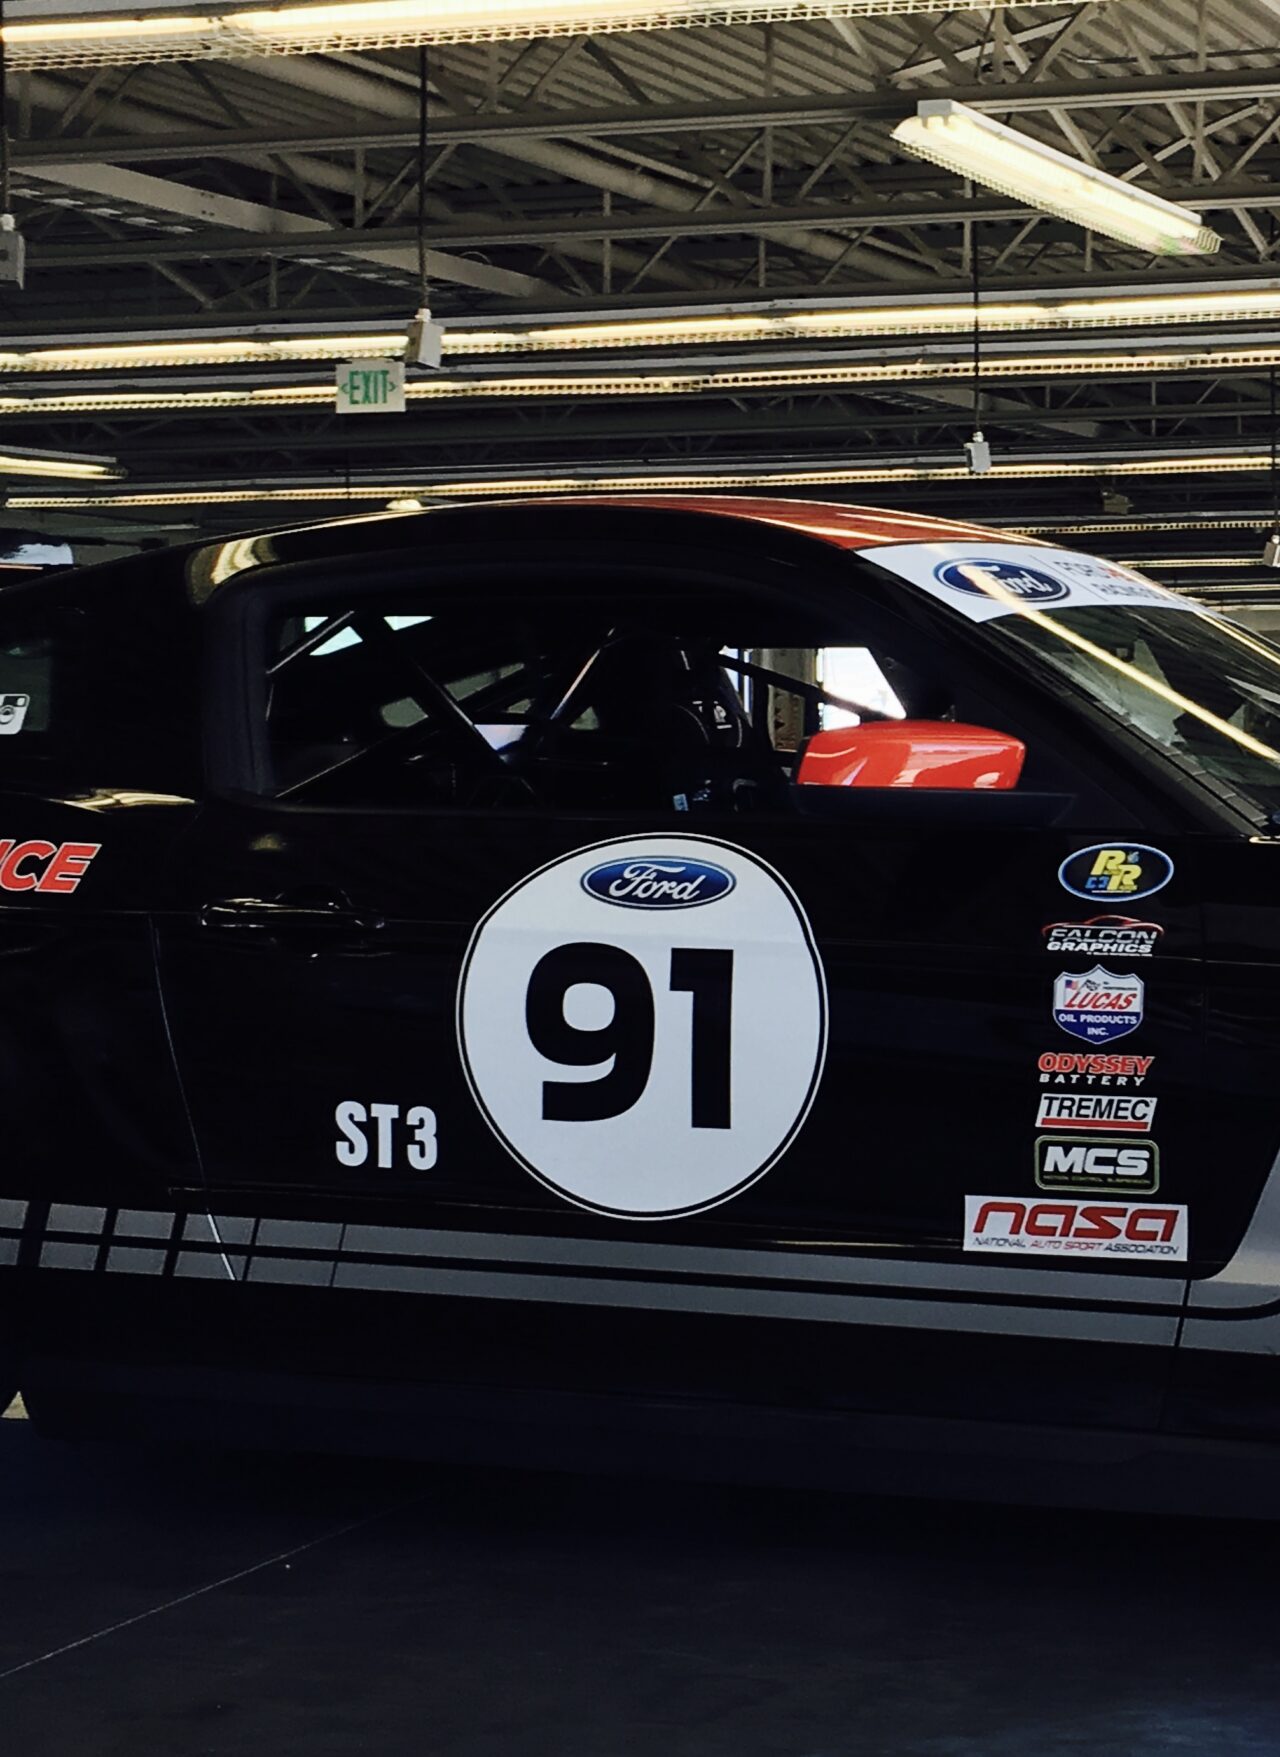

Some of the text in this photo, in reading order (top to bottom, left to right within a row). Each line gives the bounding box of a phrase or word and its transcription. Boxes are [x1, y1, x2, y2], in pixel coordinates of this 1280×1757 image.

[349, 370, 389, 404] EXIT
[0, 839, 102, 893] CE
[609, 863, 706, 900] Ford
[1049, 928, 1158, 945] FALCON
[1046, 941, 1153, 954] GRAPHICS
[1064, 992, 1138, 1010] LUCAS
[1058, 1013, 1138, 1025] OIL PRODUCTS
[525, 942, 734, 1129] 91
[1087, 1026, 1110, 1036] INC.
[1038, 1052, 1155, 1076] ODYSSEY
[1039, 1073, 1146, 1087] BATTERY
[1043, 1096, 1151, 1121] TREMEC
[1043, 1146, 1151, 1176] MCS
[973, 1236, 1180, 1255] NATIONAL AUTO SPORT ASSOCIATION
